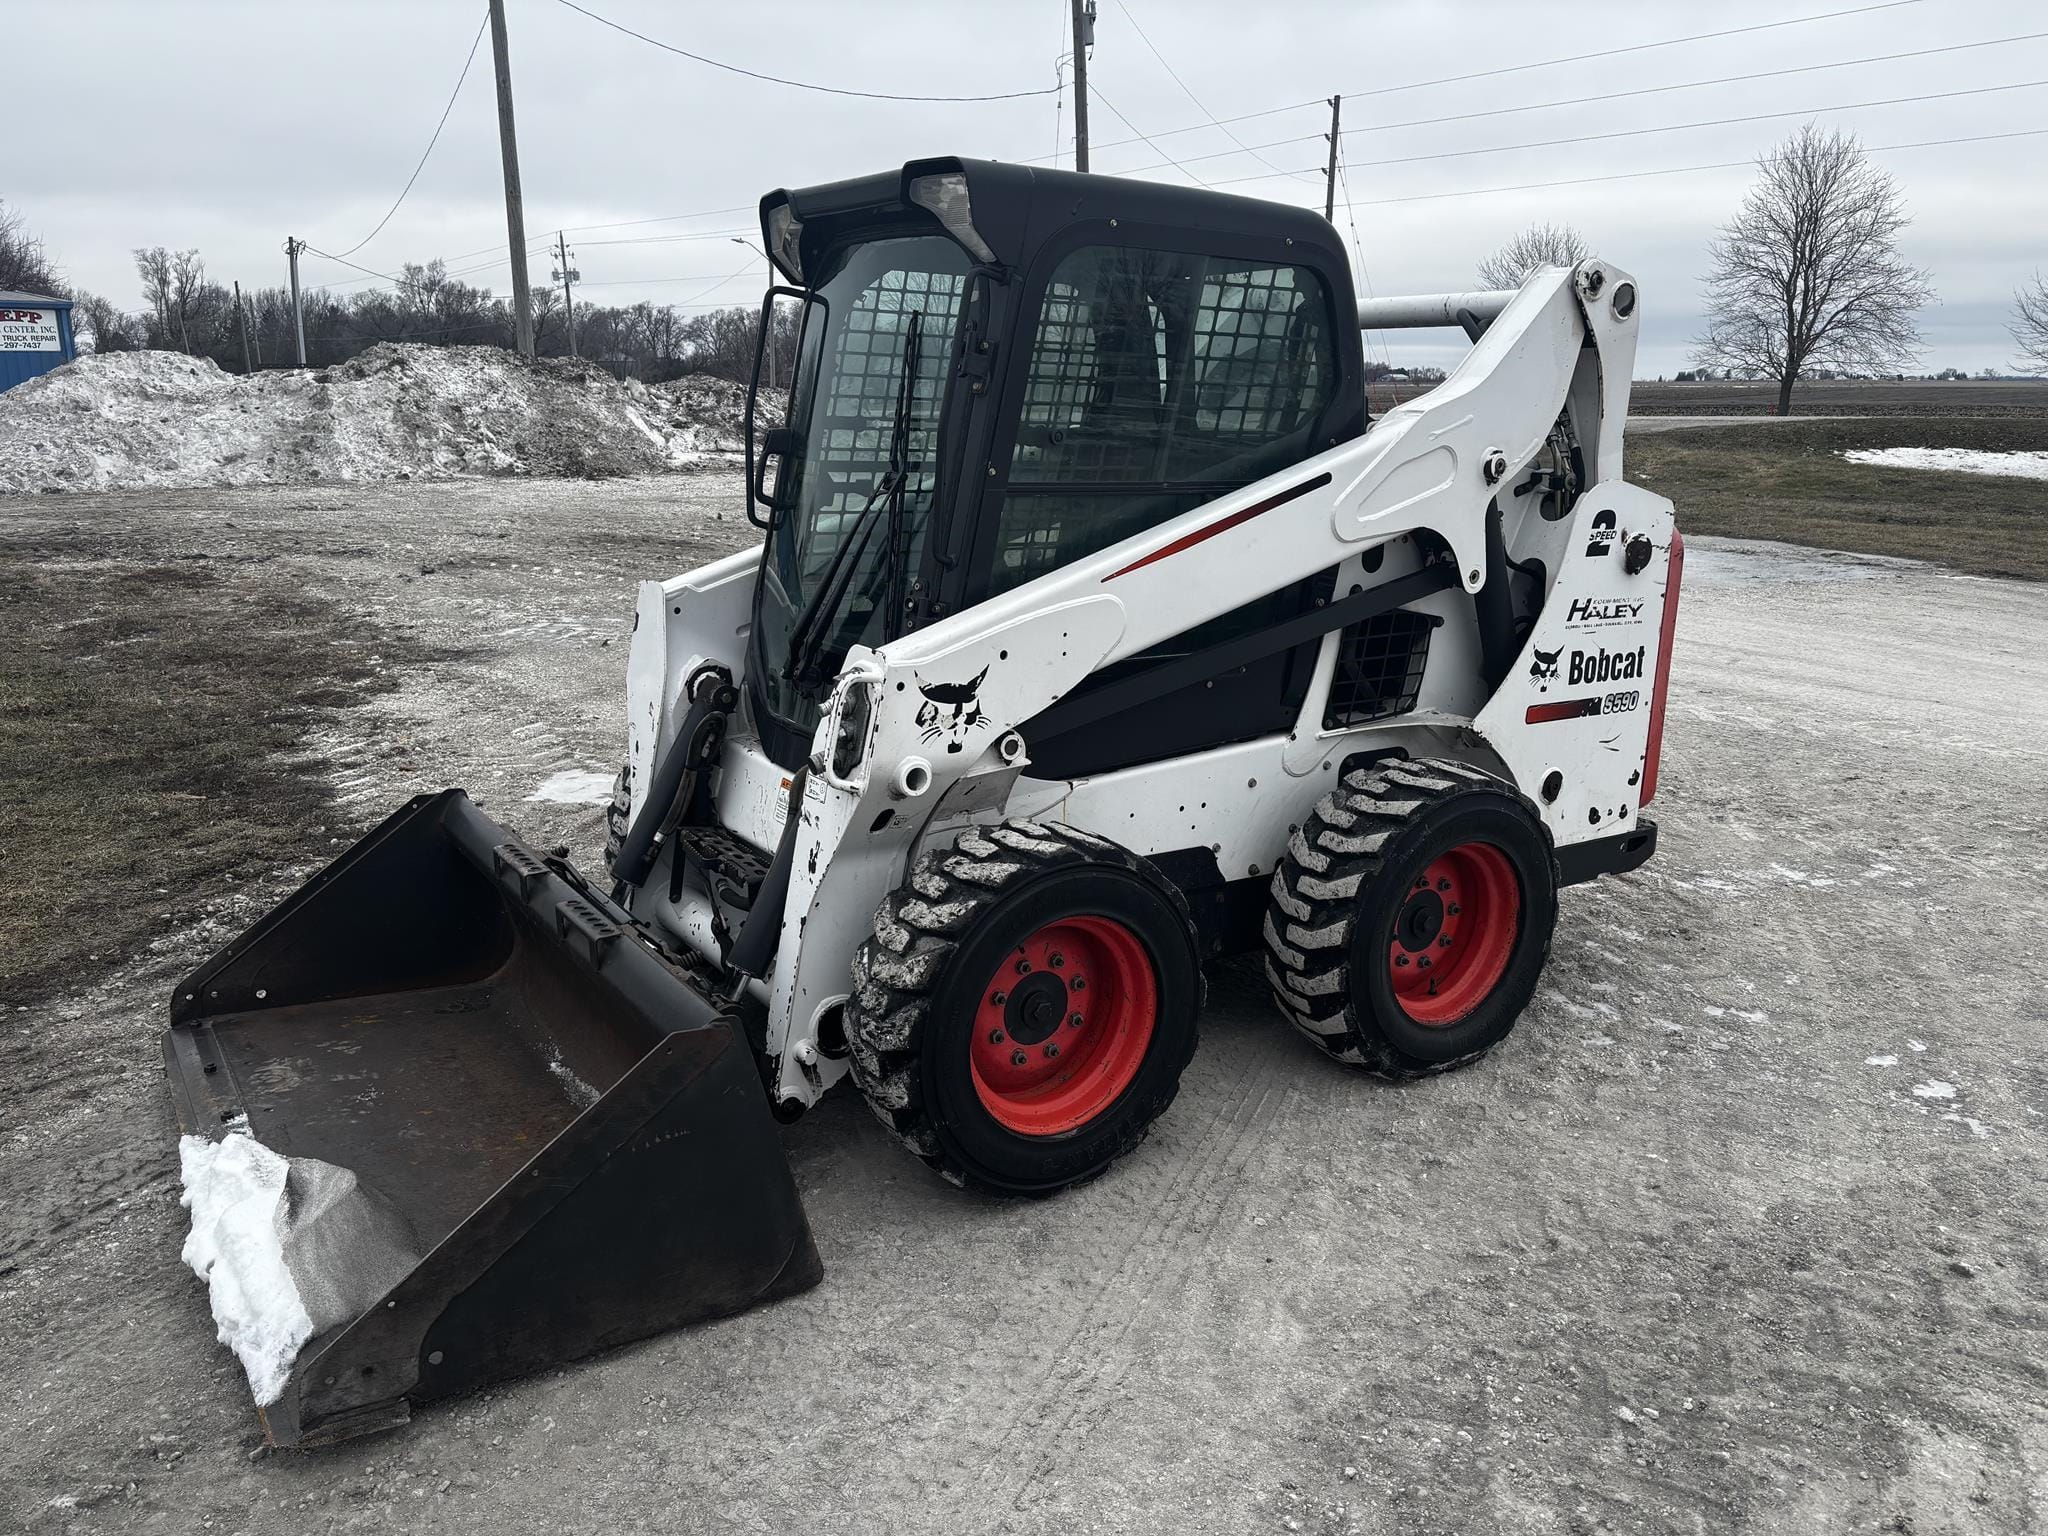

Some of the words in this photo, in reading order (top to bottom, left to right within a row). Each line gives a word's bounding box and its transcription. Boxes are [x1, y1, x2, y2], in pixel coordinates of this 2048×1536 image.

[3, 326, 38, 334] CENTER,
[40, 326, 57, 334] INC.
[1585, 509, 1617, 557] 2
[1589, 530, 1617, 541] SPEED
[1566, 598, 1644, 621] HALEY
[1568, 645, 1645, 685] Bobcat
[1602, 690, 1639, 715] S590
